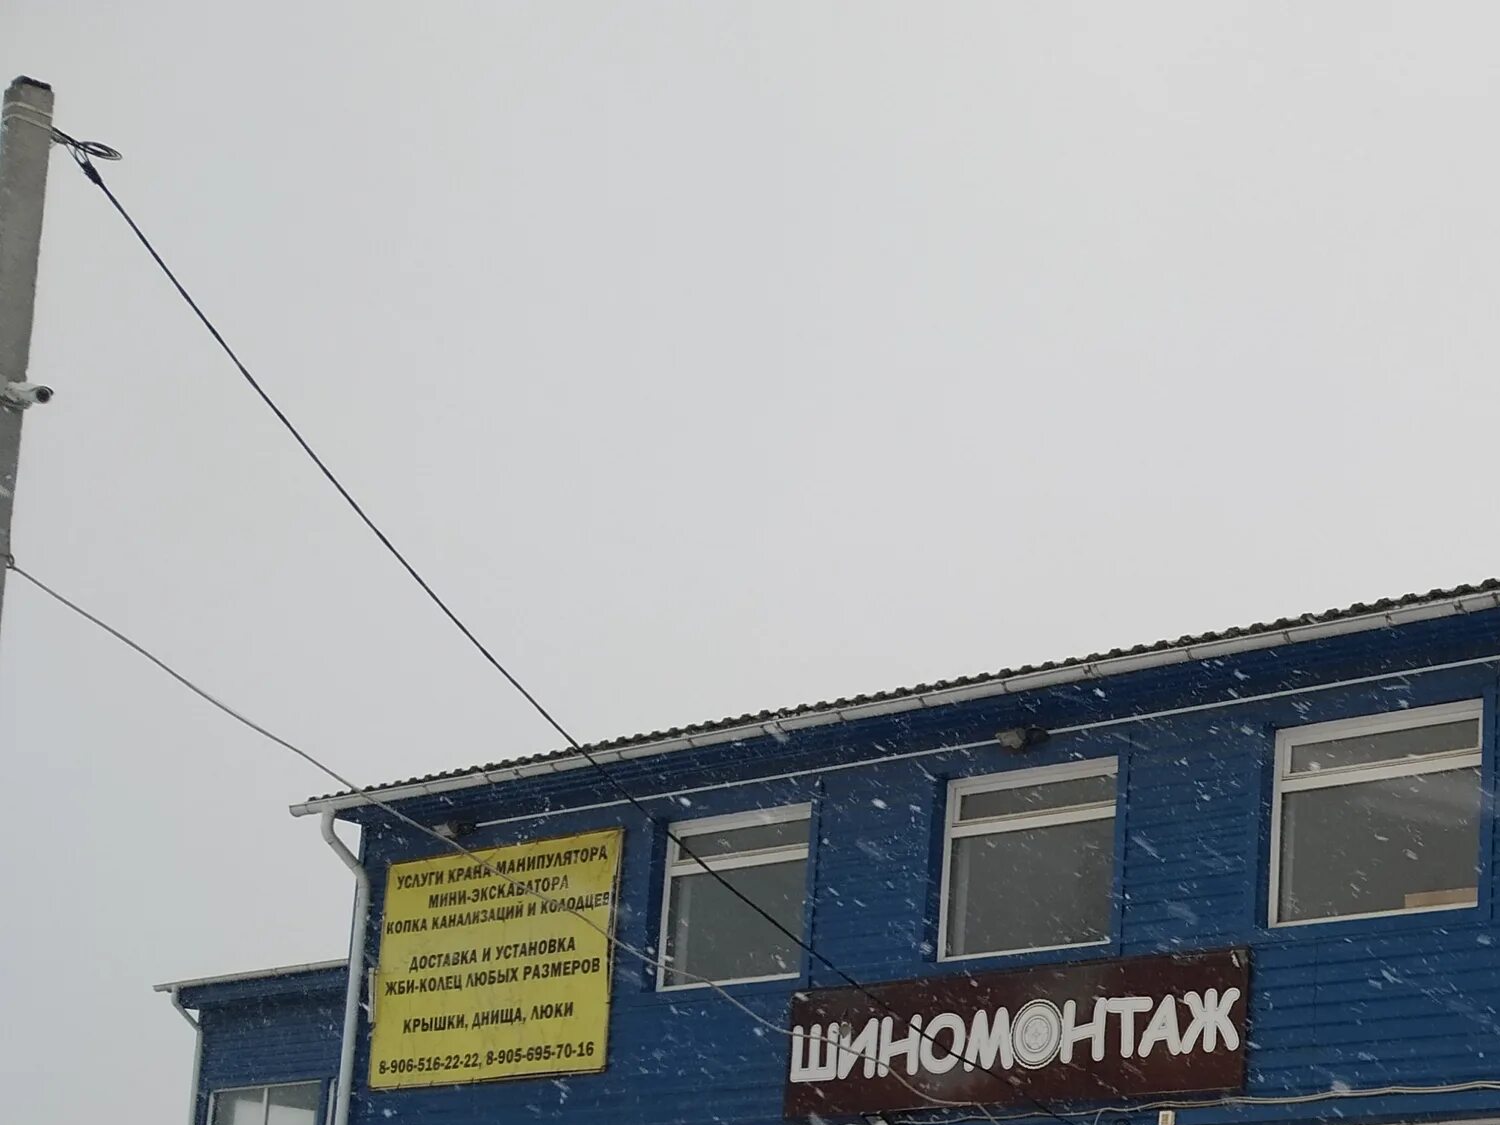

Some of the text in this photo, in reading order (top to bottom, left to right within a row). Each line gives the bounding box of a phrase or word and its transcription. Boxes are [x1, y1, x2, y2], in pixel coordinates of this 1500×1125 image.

[397, 870, 444, 890] УСЛУГИ
[428, 874, 569, 909] МИНИ-ЭКСКАВАТОРА
[386, 891, 610, 935] КОПКА КАНАЛИЗАЦИЙ И КОЛОДЦЕВ
[409, 936, 576, 973] ДОСТАВКА И УСТАНОВКА
[385, 957, 601, 996] ЖБИ-КОЛЕЦ ЛЮБЫХ РАЗМЕРОВ
[403, 1001, 574, 1034] КРЫШКИ, ДНИЩА, ЛЮКИ
[790, 987, 1241, 1083] ШИНОМОНТАЖ
[379, 1041, 595, 1075] 8-906-516-22-22, 8-905-695-70-16
